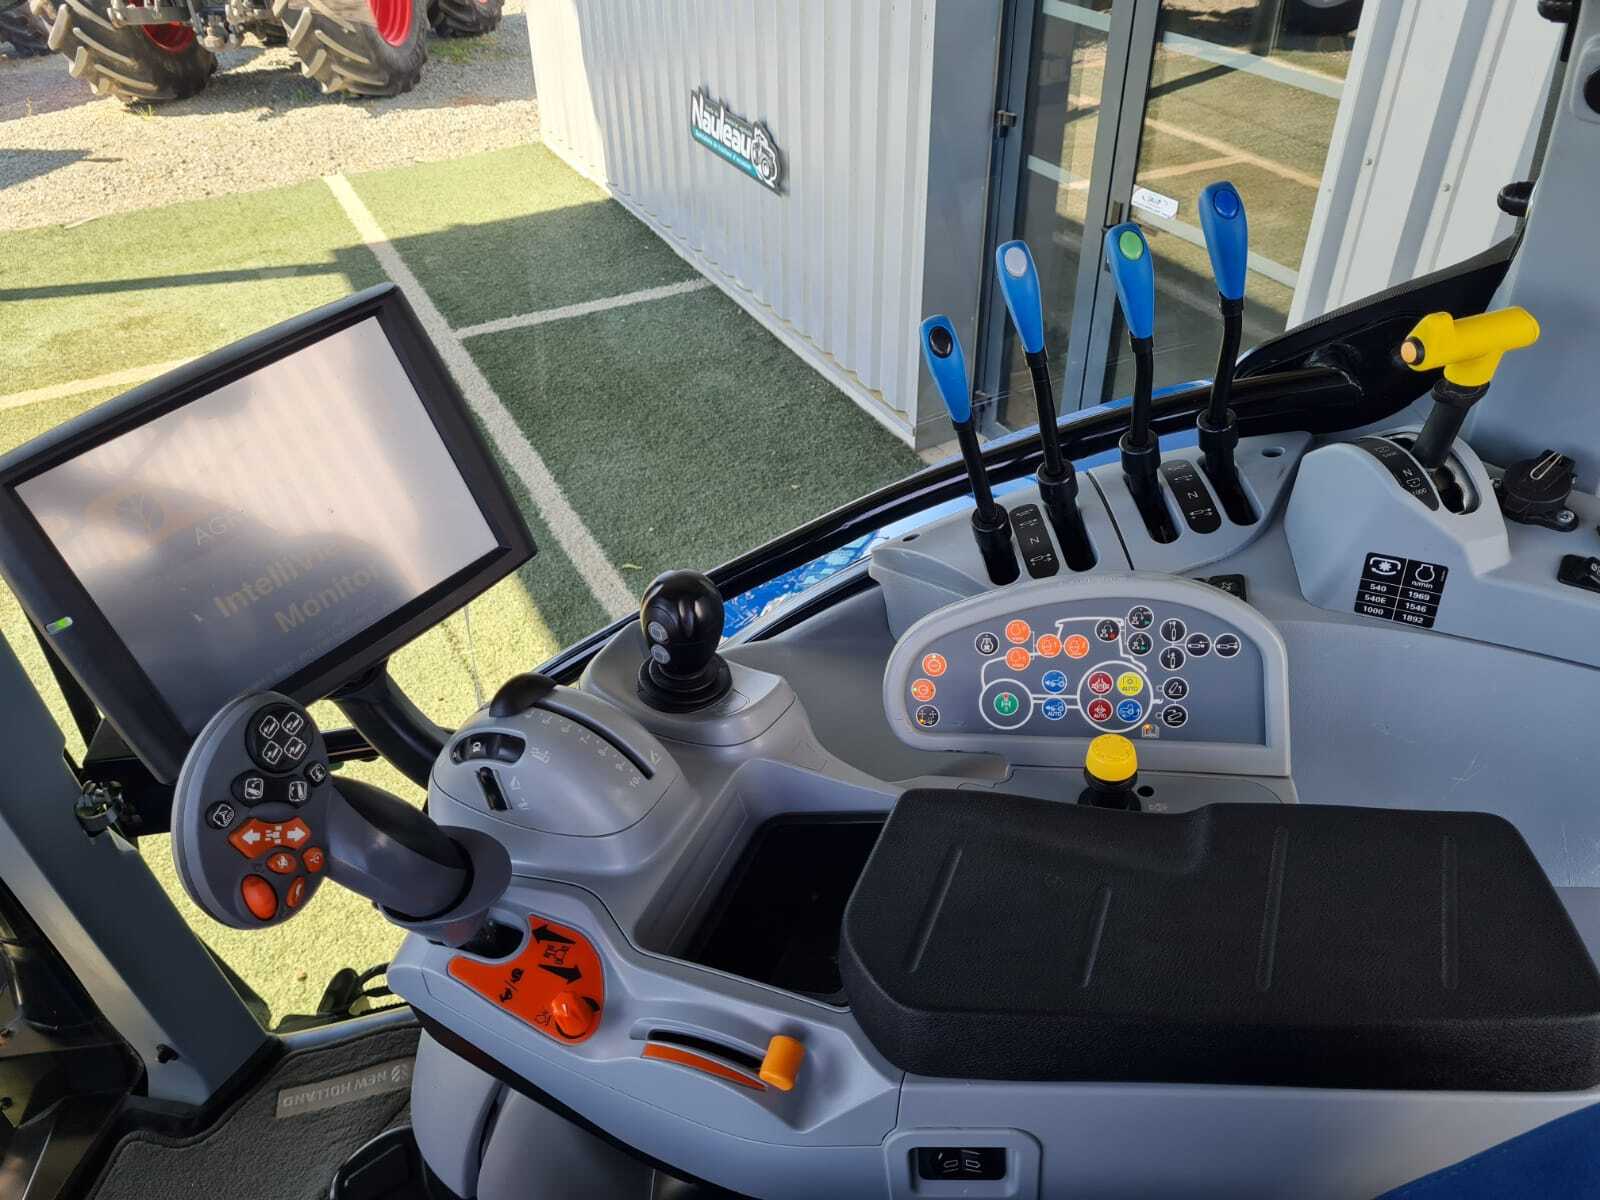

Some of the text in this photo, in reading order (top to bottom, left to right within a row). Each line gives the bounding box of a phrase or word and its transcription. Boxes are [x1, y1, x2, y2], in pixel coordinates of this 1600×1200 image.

[692, 92, 752, 160] Nauleau
[1369, 583, 1387, 592] 540
[274, 558, 384, 633] Monitor
[1364, 594, 1387, 604] 540E
[1408, 591, 1431, 601] 1969
[1363, 605, 1384, 616] 1000
[1405, 602, 1427, 613] 1546
[1402, 613, 1424, 624] 1892
[283, 1071, 386, 1107] NEW HOLLAND
